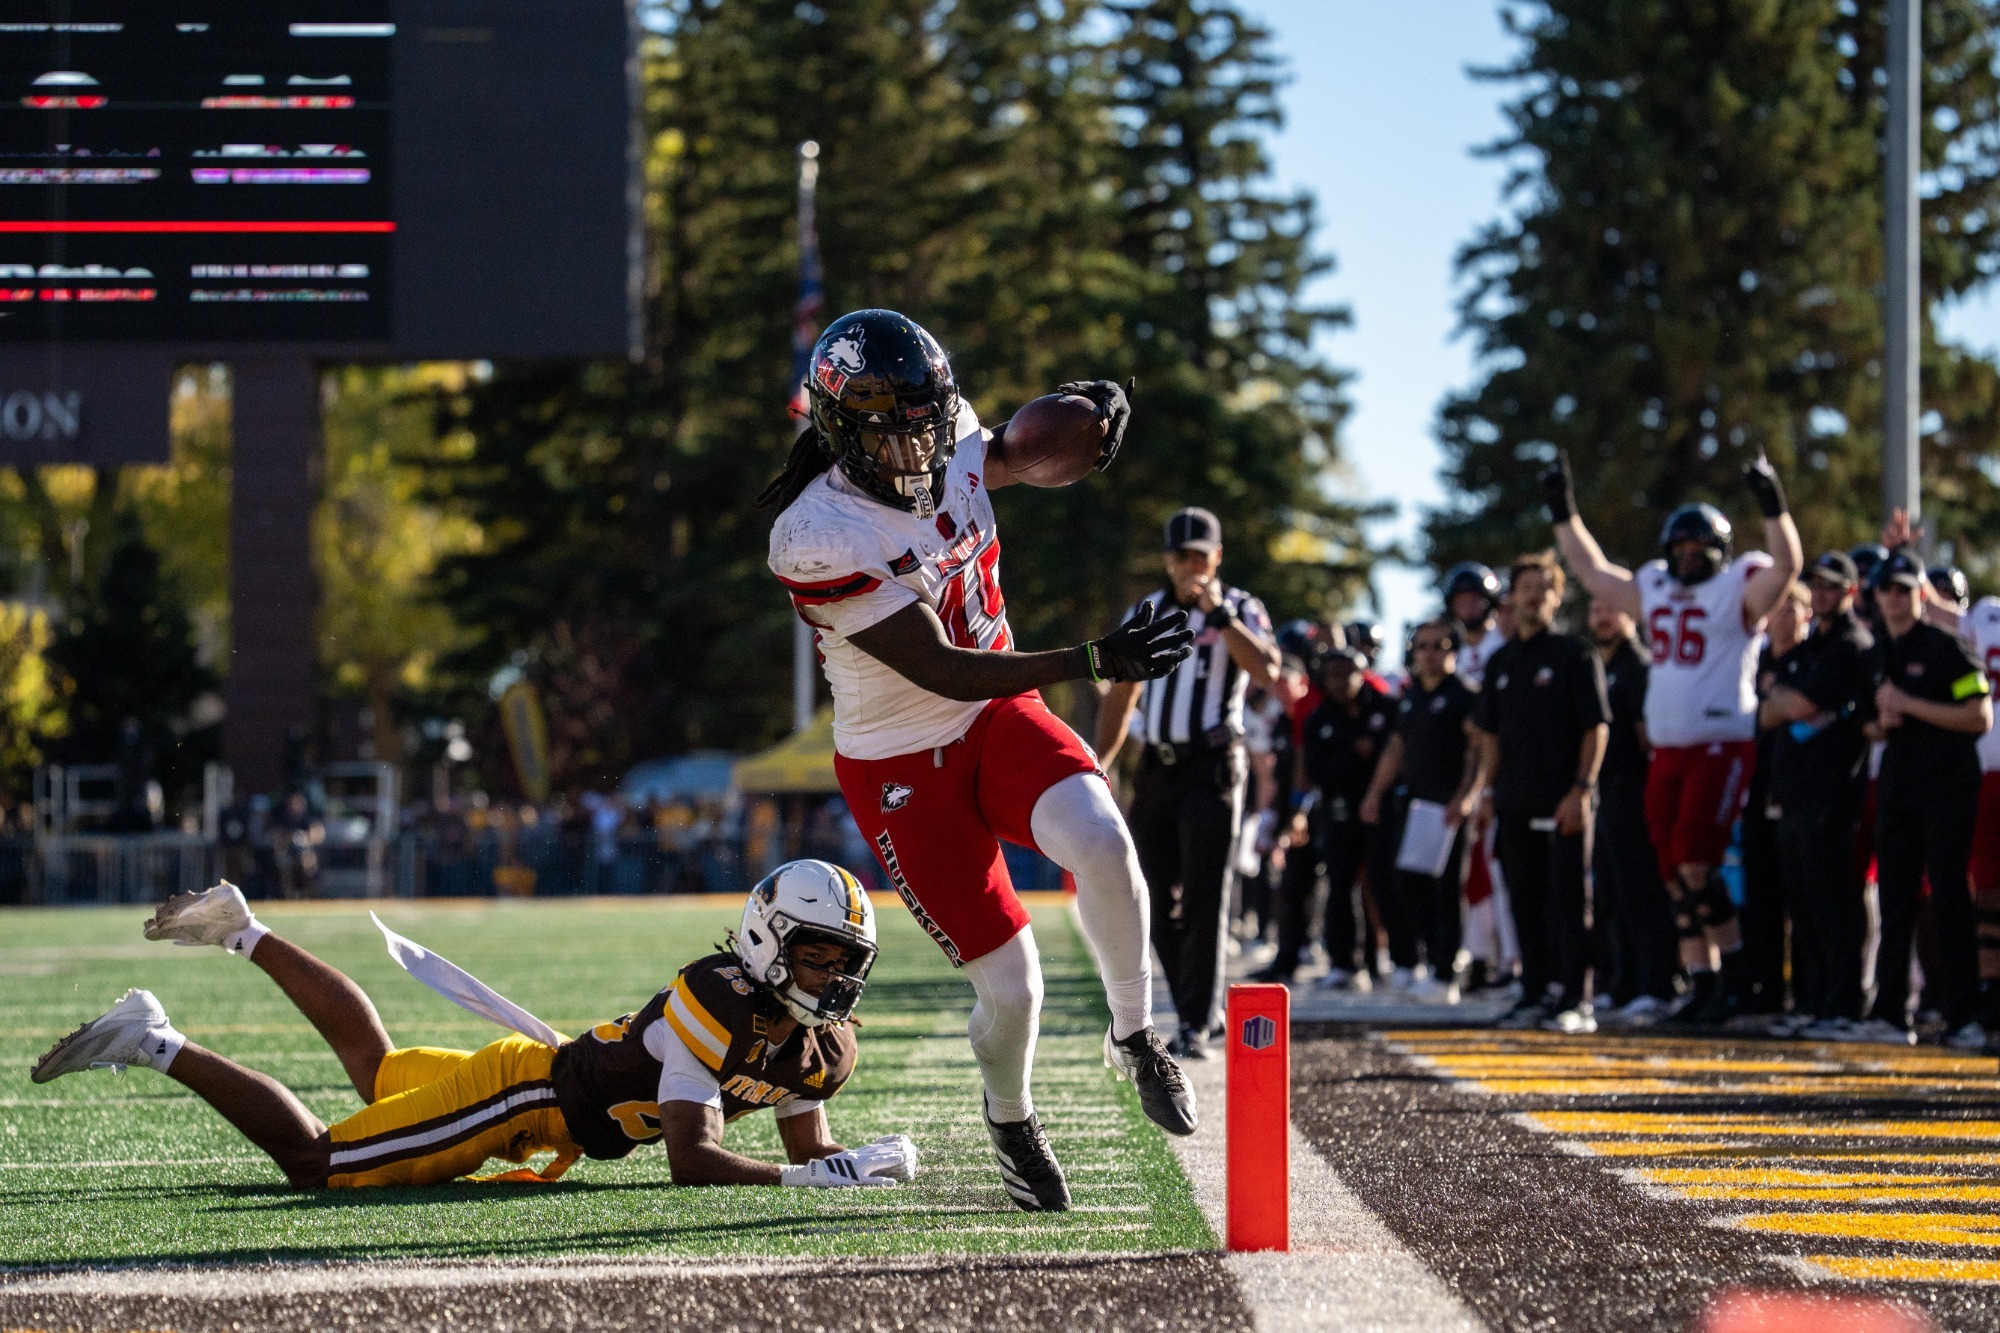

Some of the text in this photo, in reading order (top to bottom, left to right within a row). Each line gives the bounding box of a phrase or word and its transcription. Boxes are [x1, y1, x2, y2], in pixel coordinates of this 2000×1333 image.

[917, 490, 933, 519] ATTLE
[936, 518, 981, 578] NIU
[1649, 605, 1706, 667] 66
[713, 966, 754, 996] 25
[803, 1078, 824, 1089] adidas
